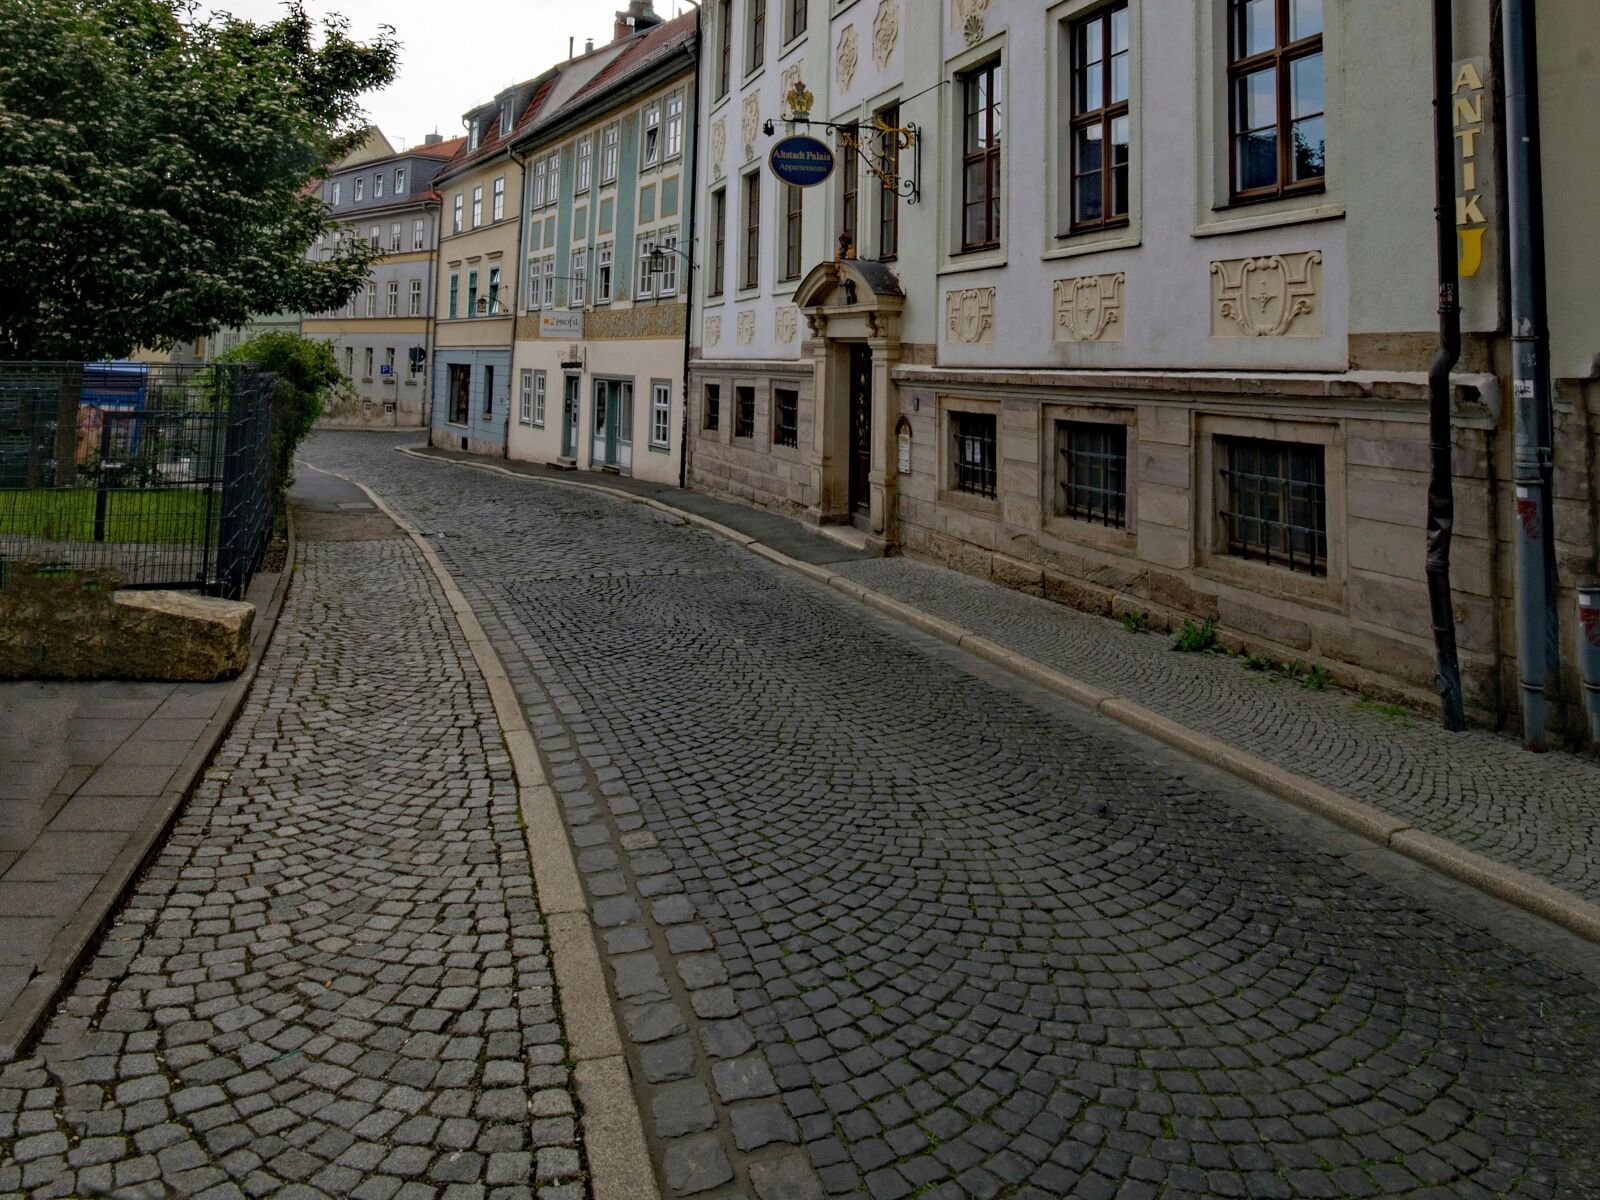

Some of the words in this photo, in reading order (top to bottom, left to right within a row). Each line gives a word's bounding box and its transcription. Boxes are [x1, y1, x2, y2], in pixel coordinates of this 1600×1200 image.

[1451, 63, 1487, 225] ANTIK
[773, 150, 804, 159] Altstadt
[807, 151, 831, 160] Palais
[779, 163, 826, 172] Appartements
